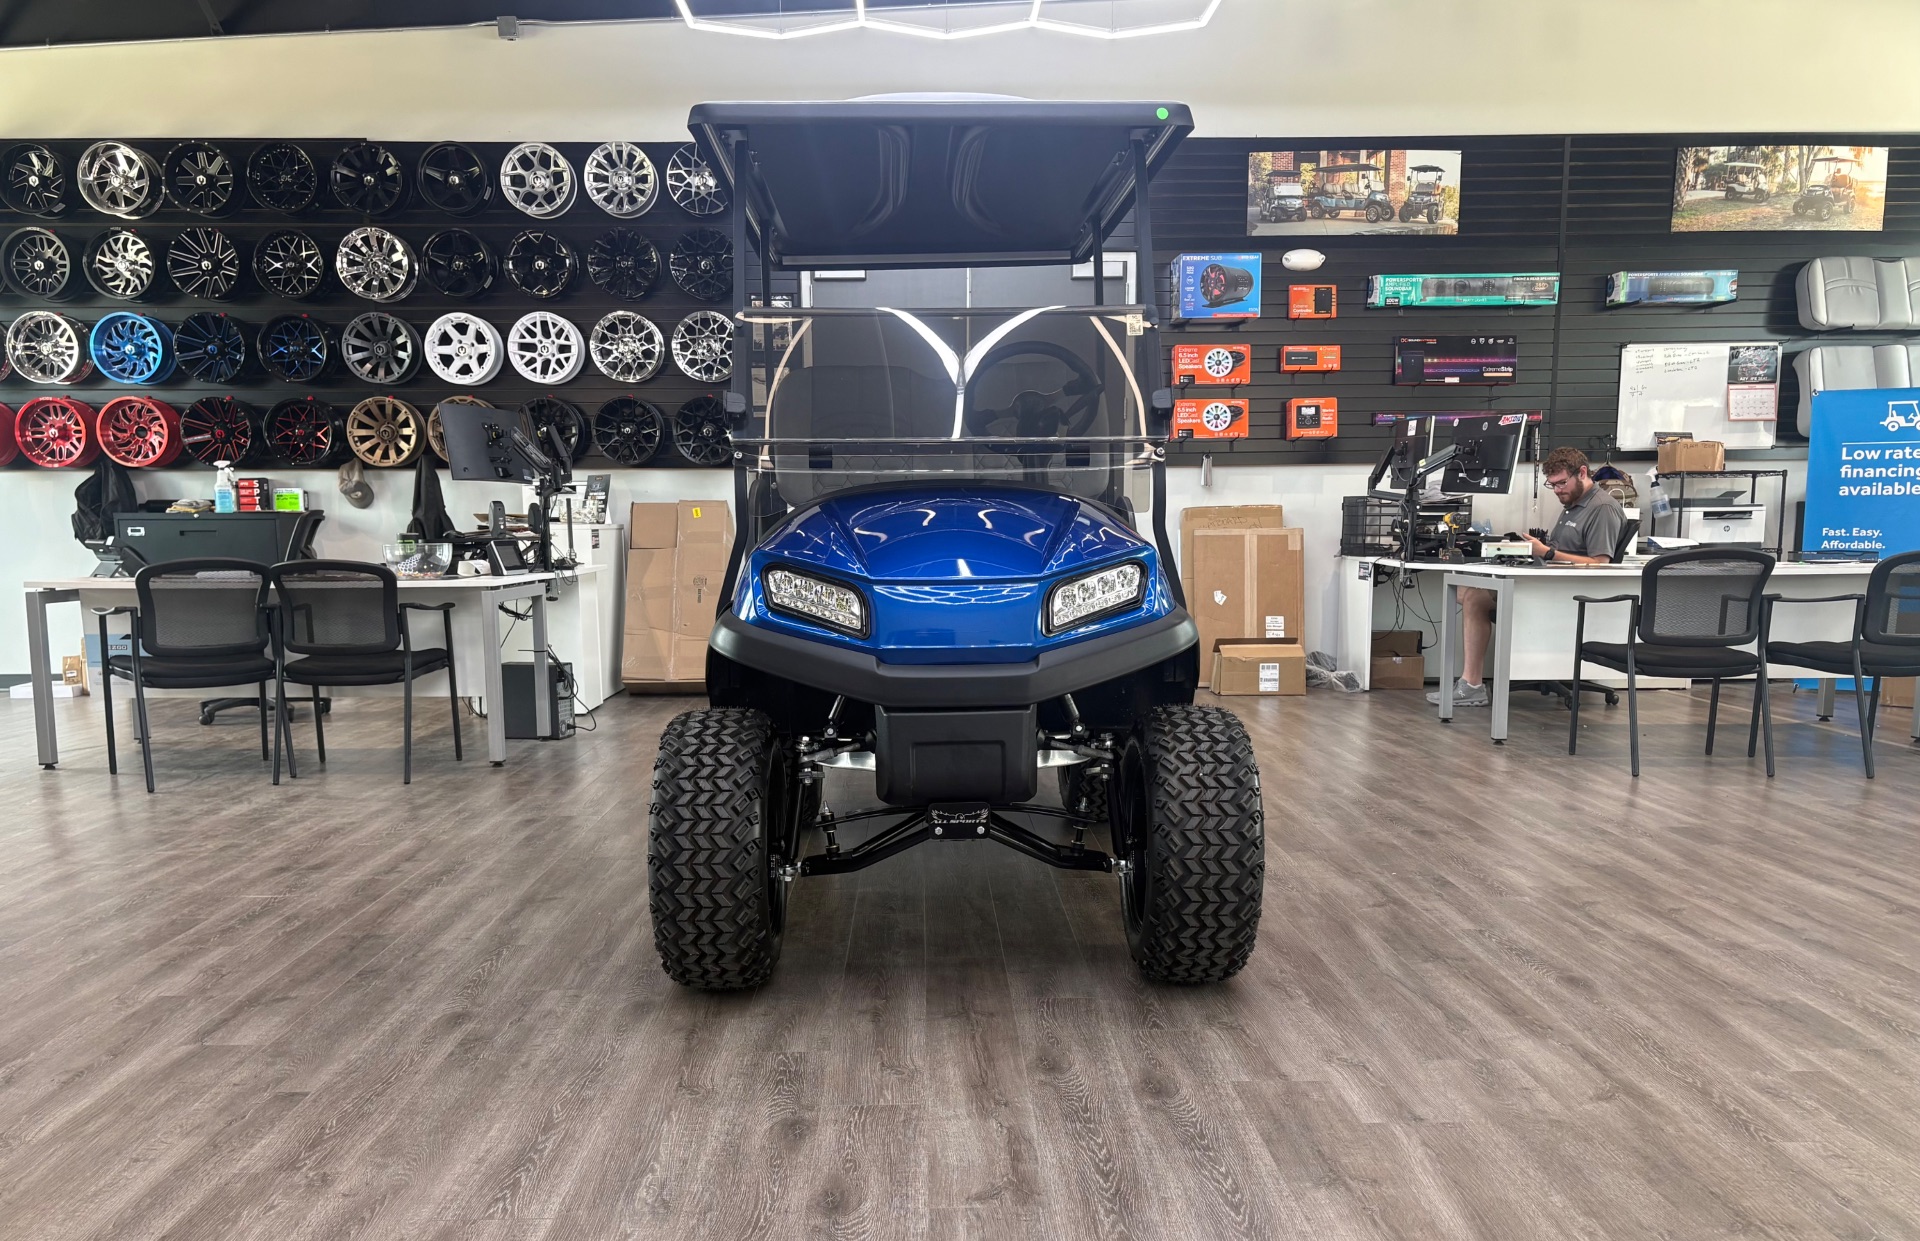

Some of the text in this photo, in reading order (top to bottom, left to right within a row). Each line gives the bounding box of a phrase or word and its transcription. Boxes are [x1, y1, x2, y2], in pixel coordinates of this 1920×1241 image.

[1842, 447, 1881, 460] Low
[1839, 482, 1920, 496] available
[1822, 528, 1882, 538] Fast. Easy.
[1821, 541, 1885, 549] Affordable.
